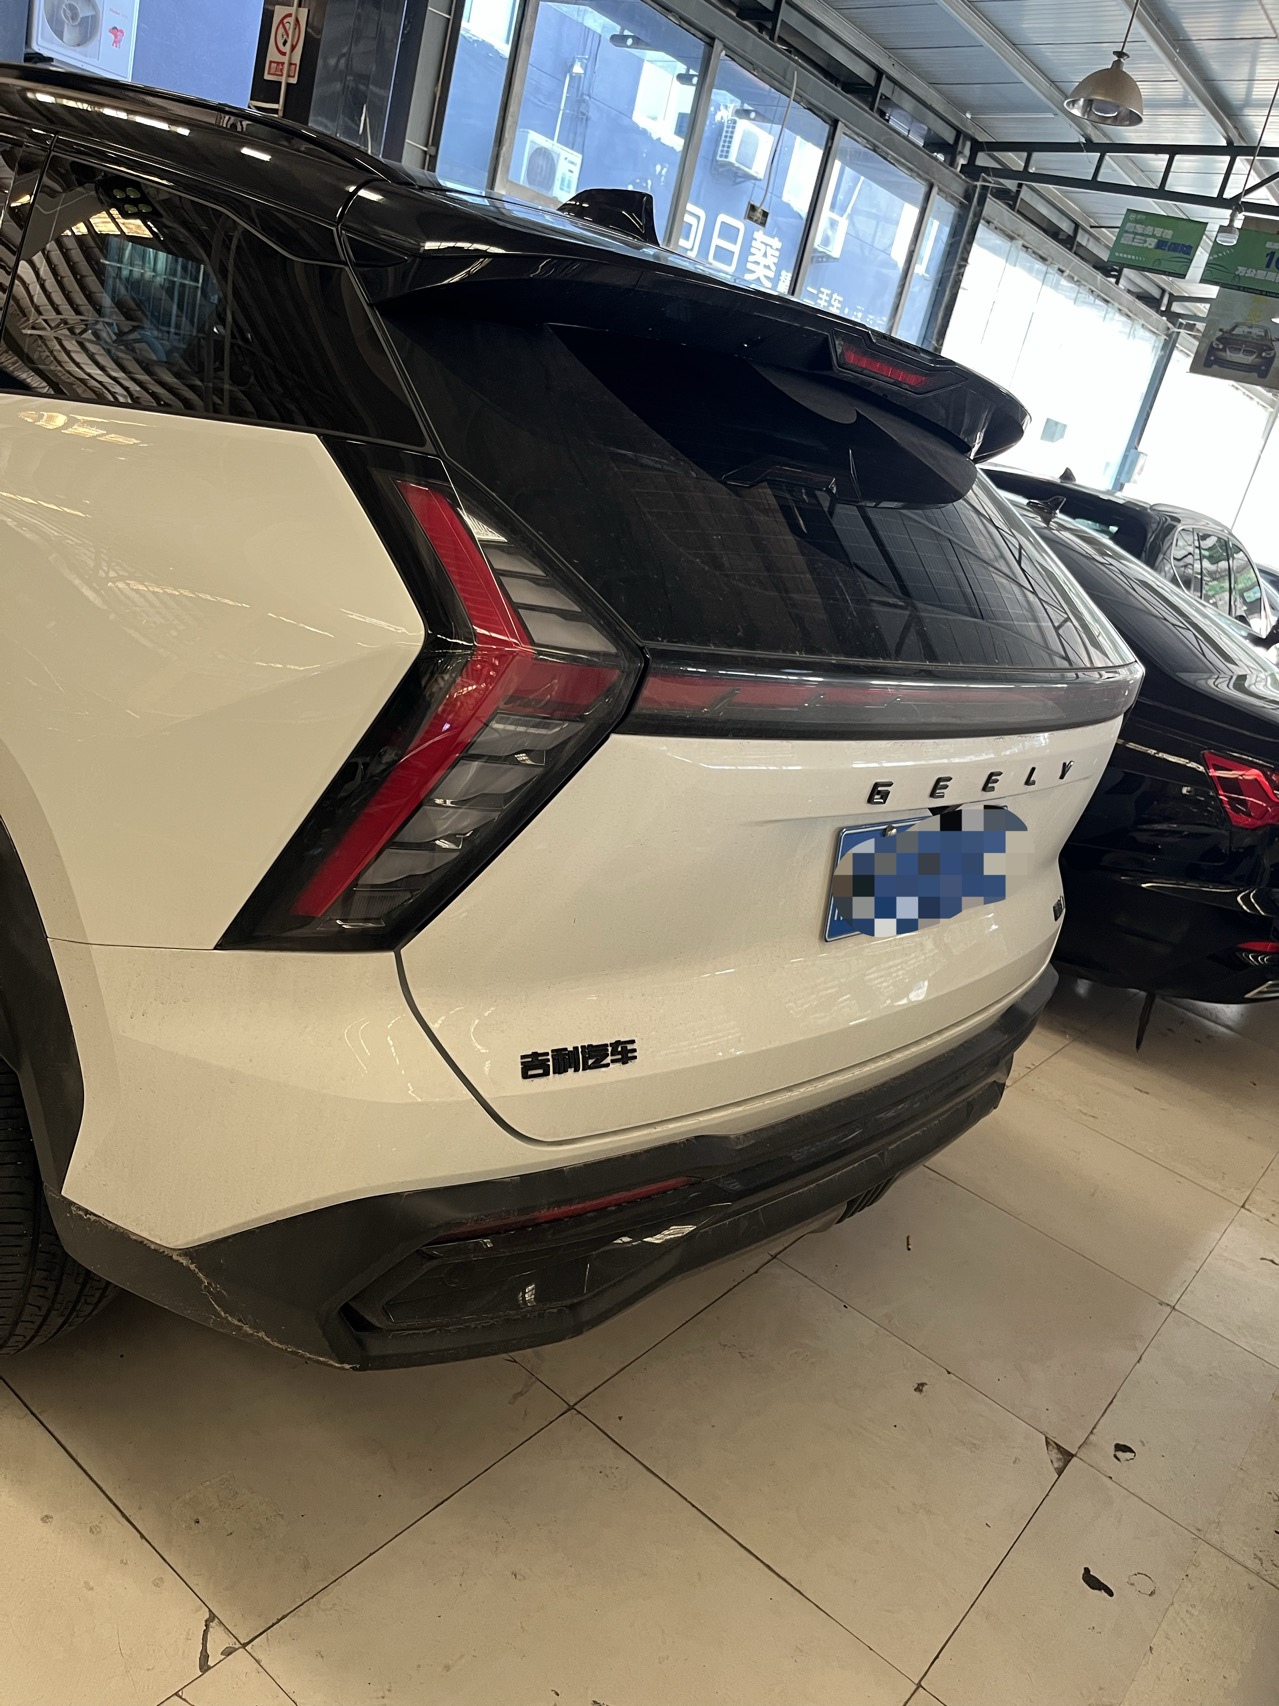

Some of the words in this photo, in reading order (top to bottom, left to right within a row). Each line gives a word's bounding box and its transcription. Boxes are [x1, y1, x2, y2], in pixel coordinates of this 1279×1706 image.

[867, 760, 1074, 805] GEELY
[520, 1039, 637, 1079] 吉利汽车
